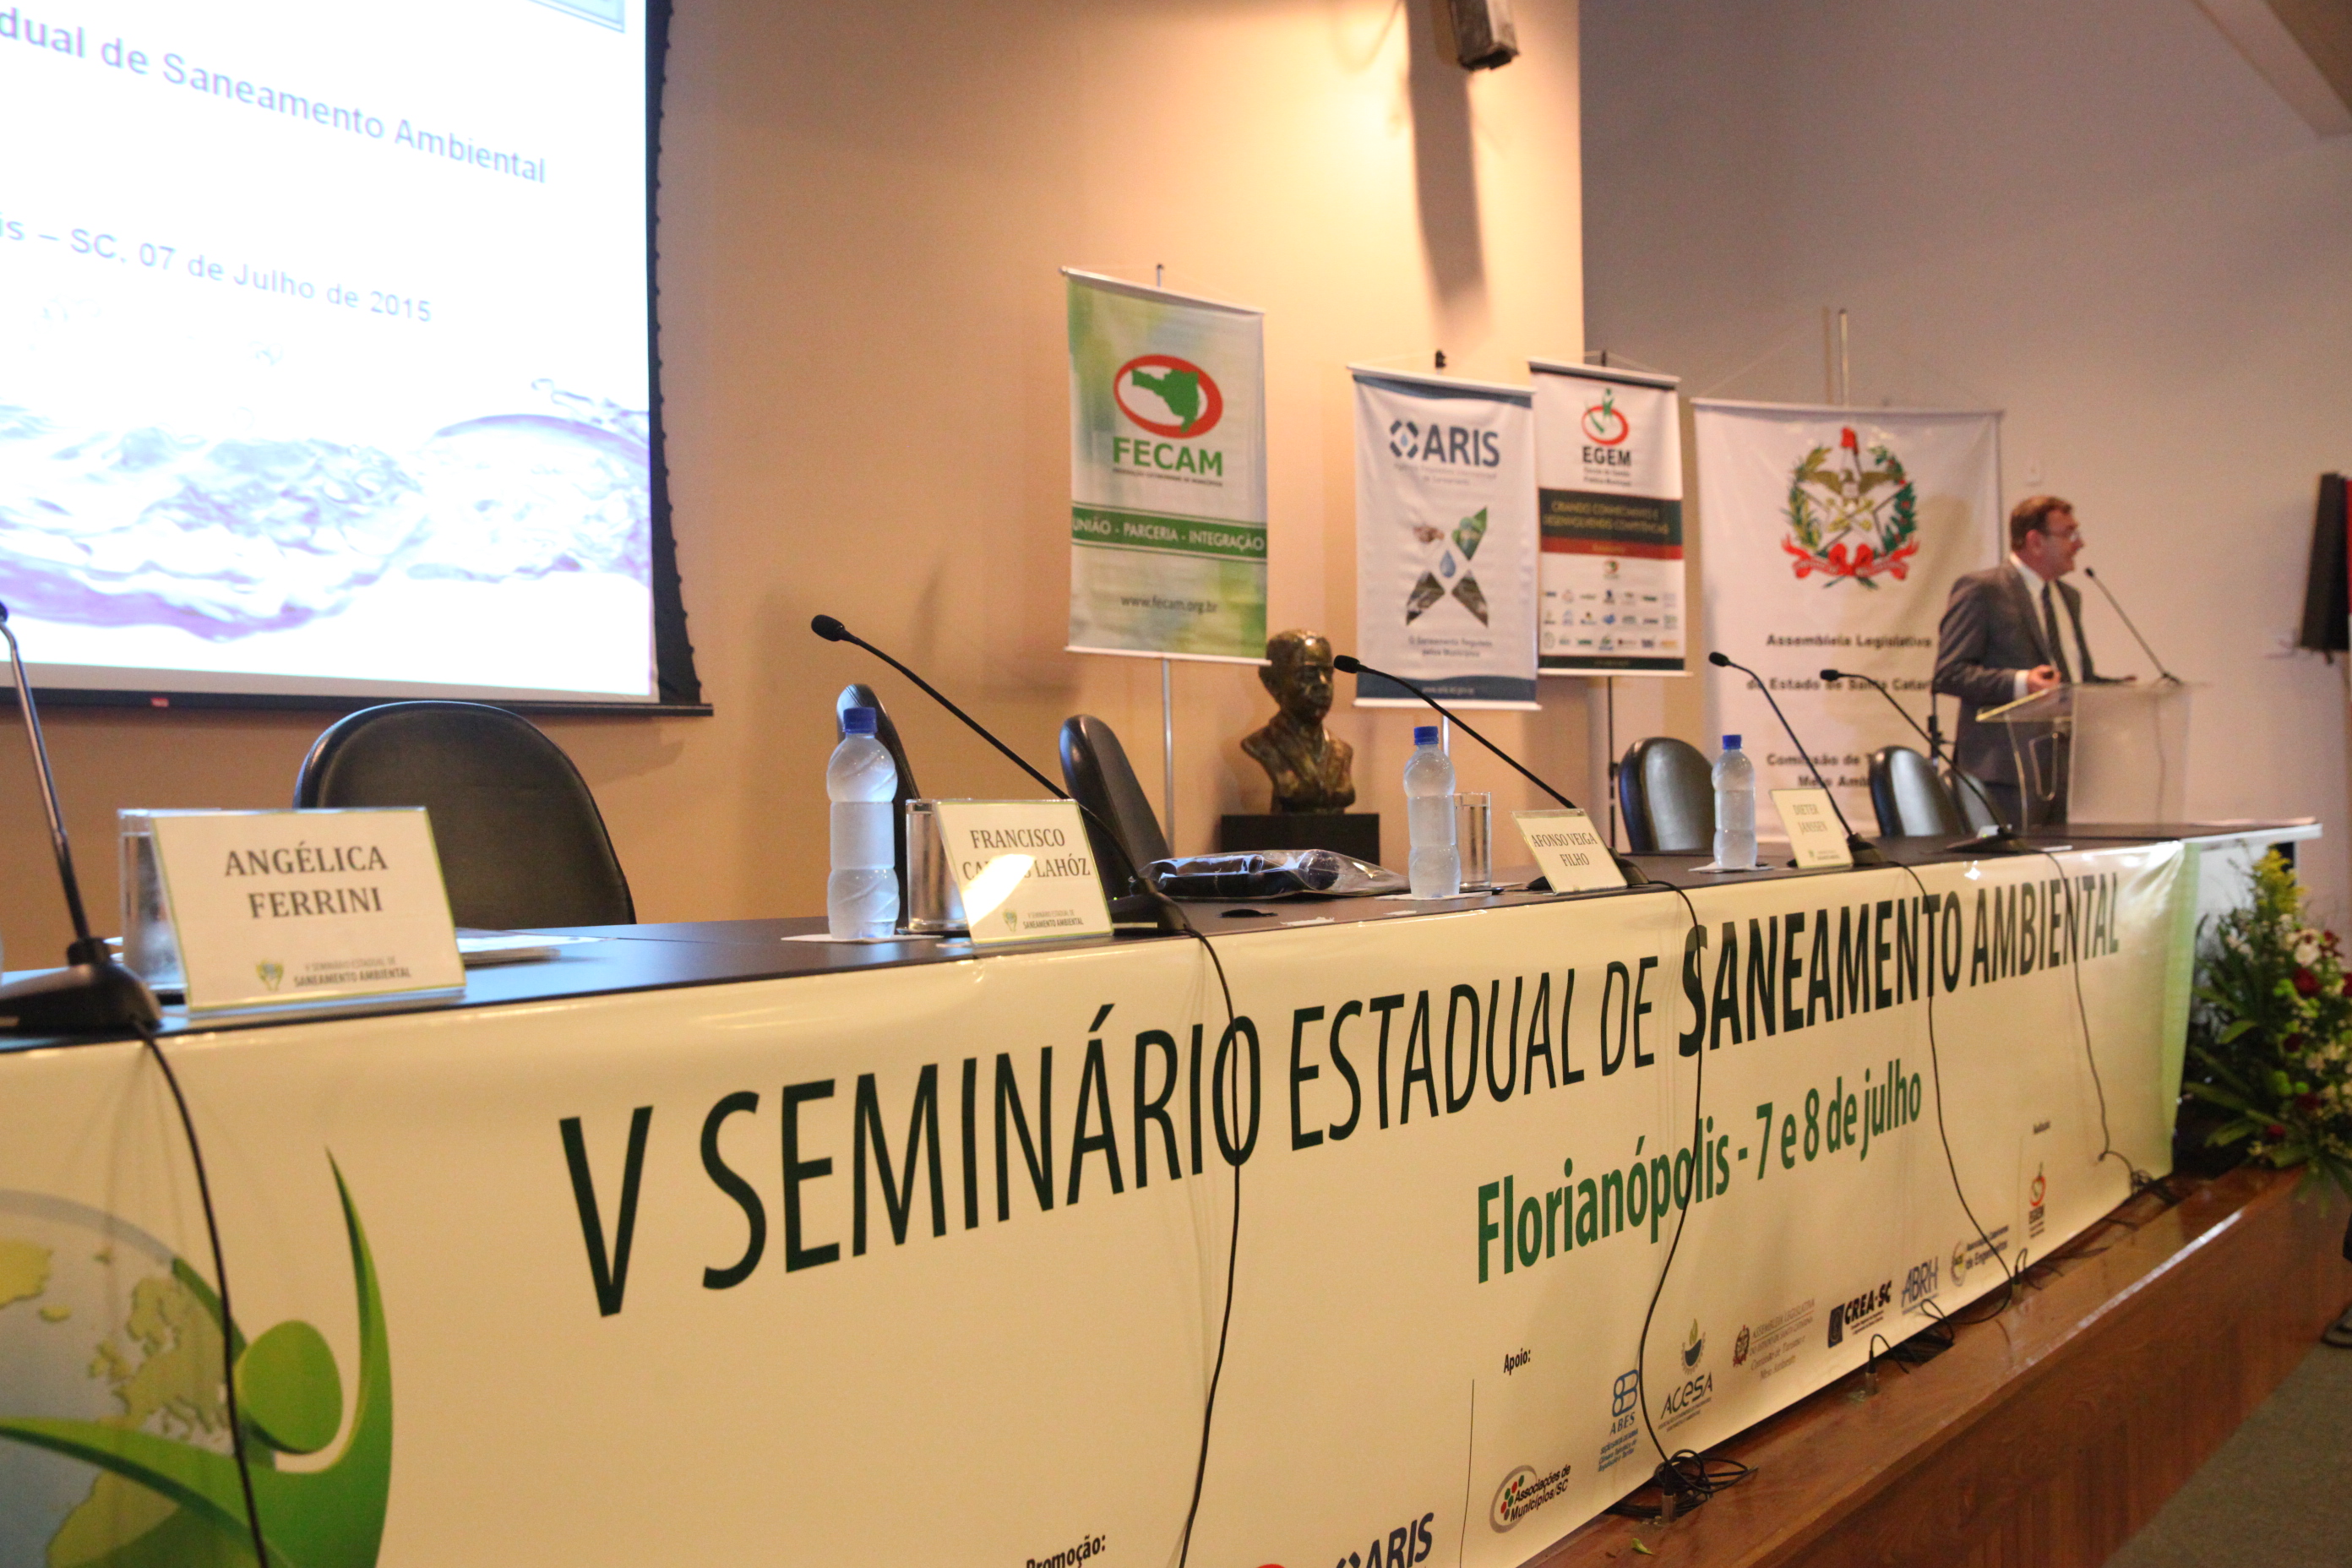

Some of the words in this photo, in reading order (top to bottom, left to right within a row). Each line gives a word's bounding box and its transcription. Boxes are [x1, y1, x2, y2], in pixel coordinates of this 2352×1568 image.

[101, 37, 150, 75] de
[163, 52, 385, 139] Saneamento
[395, 118, 547, 184] Ambiental
[139, 242, 177, 270] 07
[188, 254, 224, 281] de
[233, 264, 315, 298] Julho
[327, 283, 359, 308] de
[370, 291, 432, 323] 2015
[1113, 436, 1223, 477] FECAM
[1423, 424, 1500, 467] ARIS
[1582, 445, 1632, 466] EGEM
[1073, 516, 1111, 536] UNIÃO
[1123, 522, 1179, 542] PARCERIA
[1189, 531, 1265, 552] INTEGRAÇÃO
[1120, 595, 1217, 615] www.fecam.org.br
[1767, 634, 1851, 647] Assembleia
[1855, 634, 1932, 651] Legislativa
[1769, 678, 1820, 690] Estado
[1893, 678, 1936, 691] Catar
[1767, 753, 1838, 765] Comisão
[1843, 753, 1860, 765] de
[1798, 775, 1832, 787] Meo
[970, 828, 1066, 849] FRANCISCO
[1531, 833, 1569, 847] AFONSO
[1568, 832, 1598, 846] VEIGA
[225, 841, 388, 877] ANGÉLICA
[1034, 853, 1091, 879] LAHÓZ
[1560, 852, 1590, 867] FILHO
[248, 886, 384, 919] FERRINI
[1023, 919, 1056, 929] SANEAMENTO
[1056, 917, 1084, 927] AMBIENTAL
[294, 972, 357, 987] SANEAMENTO
[359, 966, 411, 980] AMBIENTAL
[559, 1105, 654, 1317] V
[700, 1002, 1260, 1289] SEMINÁRIO
[1290, 968, 1585, 1152] ESTADUAL
[1601, 956, 1658, 1076] DE
[1679, 890, 1962, 1058] SANEAMENTO
[1970, 873, 2119, 988] AMBIENTAL
[1478, 1115, 1730, 1284] Florianópolis
[1756, 1102, 1773, 1181] 7
[1781, 1113, 1797, 1169] e
[1804, 1088, 1820, 1162] 8
[1827, 1076, 1858, 1154] de
[1860, 1058, 1921, 1162] julho
[1901, 1257, 1939, 1308] ABRH
[1845, 1280, 1892, 1325] CREA-SC
[1504, 1348, 1531, 1375] Apoio:
[1609, 1412, 1635, 1436] ABES
[1514, 1471, 1560, 1505] Associações
[1561, 1463, 1571, 1478] de
[1511, 1478, 1569, 1522] Municípios/SC
[1366, 1512, 1435, 1568] ARIS
